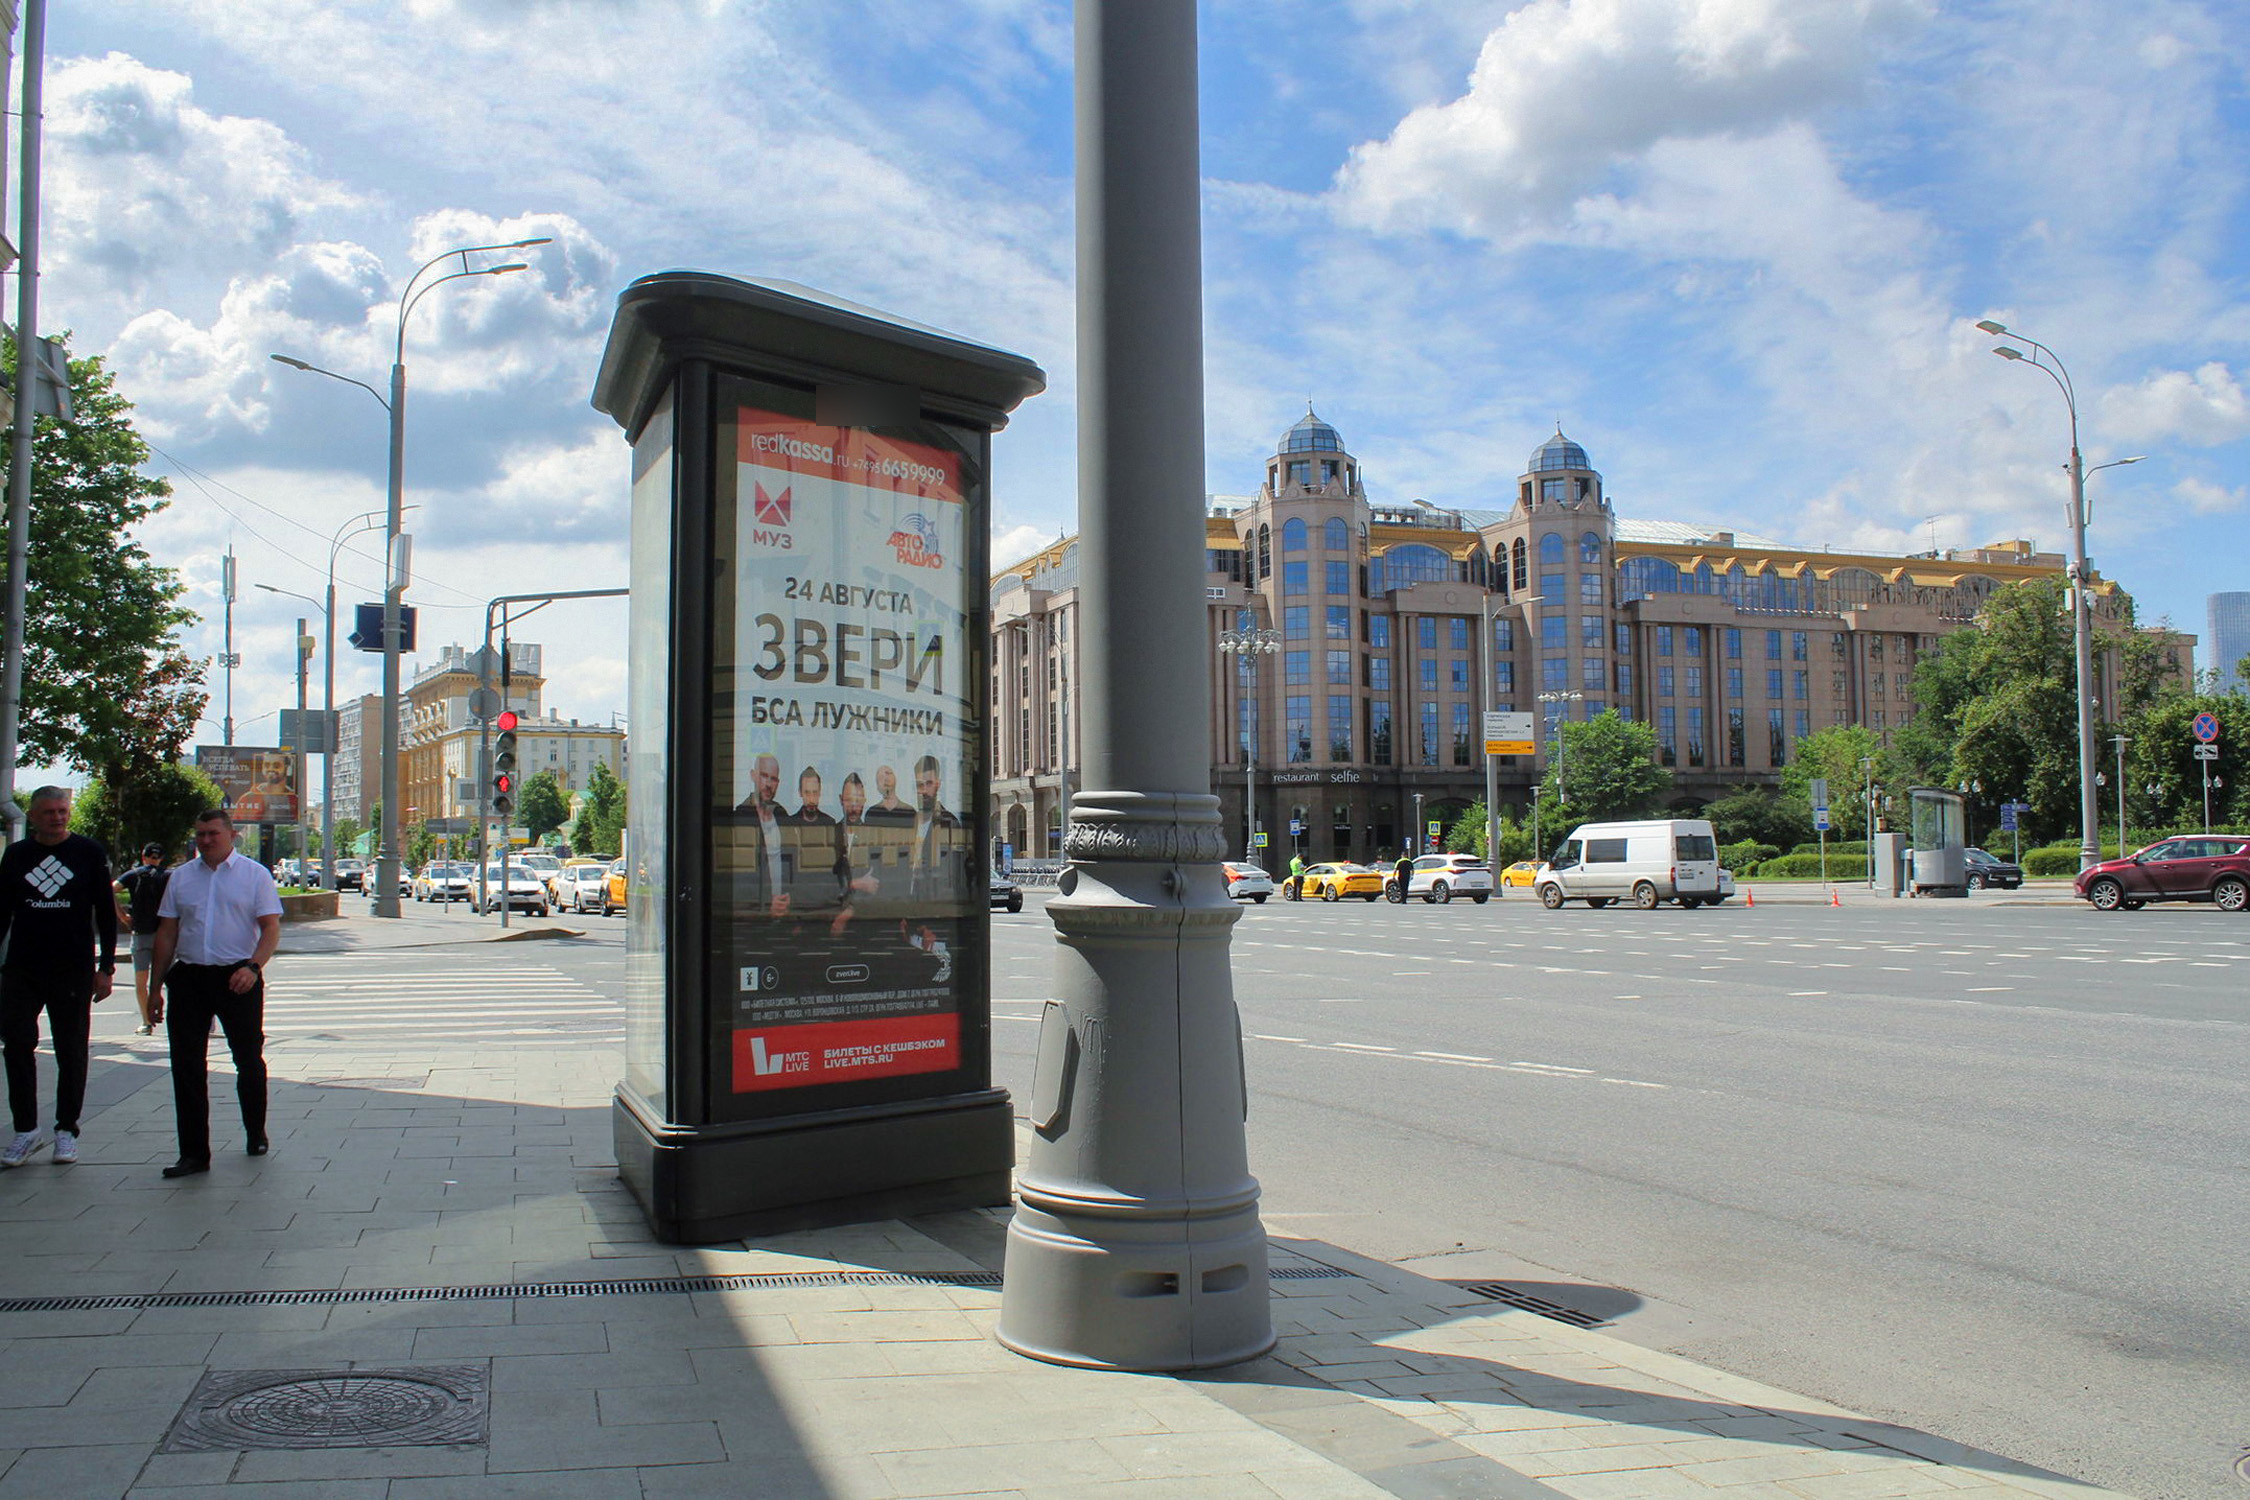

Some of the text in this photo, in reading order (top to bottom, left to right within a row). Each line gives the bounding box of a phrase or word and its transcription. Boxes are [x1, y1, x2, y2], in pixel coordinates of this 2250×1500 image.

[751, 433, 850, 468] redkassa.ru
[753, 529, 792, 549] МУЗ
[886, 530, 923, 551] АВТО
[897, 546, 942, 569] РАДИО
[785, 576, 913, 615] 24 АВГУСТА
[752, 612, 943, 696] ЗВЕРИ
[752, 696, 943, 736] БСА ЛУЖНИКИ
[1273, 772, 1320, 783] restaurant
[1330, 770, 1360, 783] selfie
[785, 1051, 810, 1062] МТС
[824, 1039, 946, 1059] БИЛЕТЫ С КЕШБЭКОМ
[785, 1062, 809, 1073] LIVE
[824, 1053, 894, 1069] LIVE.MTS.RU
